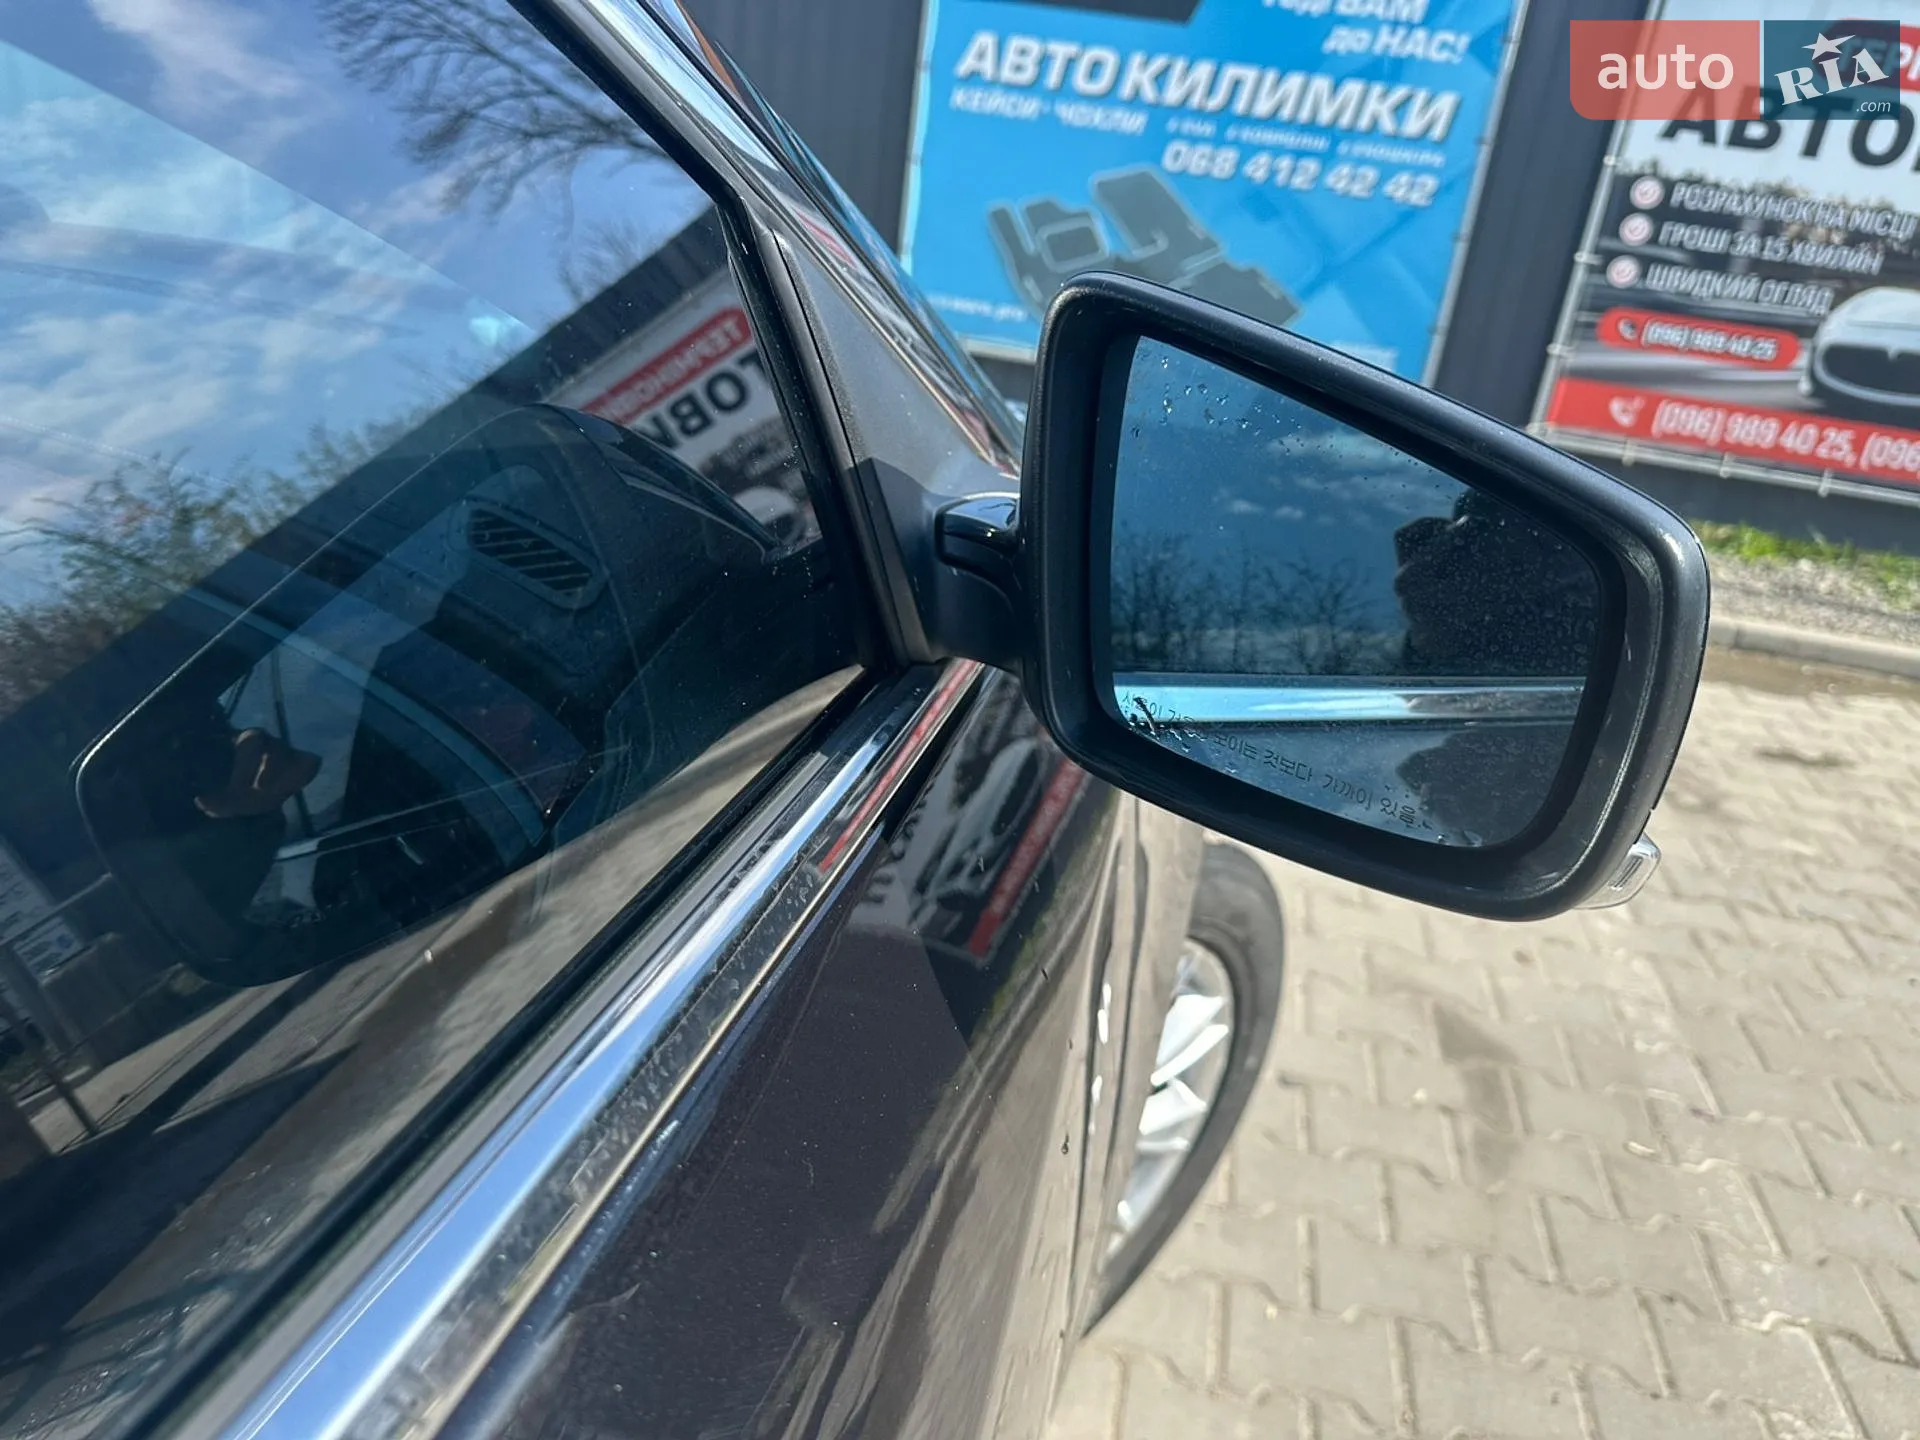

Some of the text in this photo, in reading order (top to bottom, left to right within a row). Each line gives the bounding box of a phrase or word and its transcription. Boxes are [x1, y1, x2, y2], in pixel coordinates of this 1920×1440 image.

[1371, 21, 1472, 64] НАС!
[1659, 81, 1920, 172] АВТО
[1161, 139, 1240, 180] 068
[1242, 149, 1322, 190] 412
[1324, 162, 1380, 198] 42
[1382, 170, 1440, 207] 42
[1787, 240, 1885, 276] ХВИЛИН
[1646, 263, 1835, 316] ШВИДКИЙ ОГЛЯД
[1651, 399, 1727, 448] (096)
[1724, 412, 1780, 449] 989
[1779, 419, 1819, 455] 40
[1859, 432, 1920, 479] (096
[1262, 749, 1313, 783] 것보다
[1322, 773, 1372, 810] 가까이
